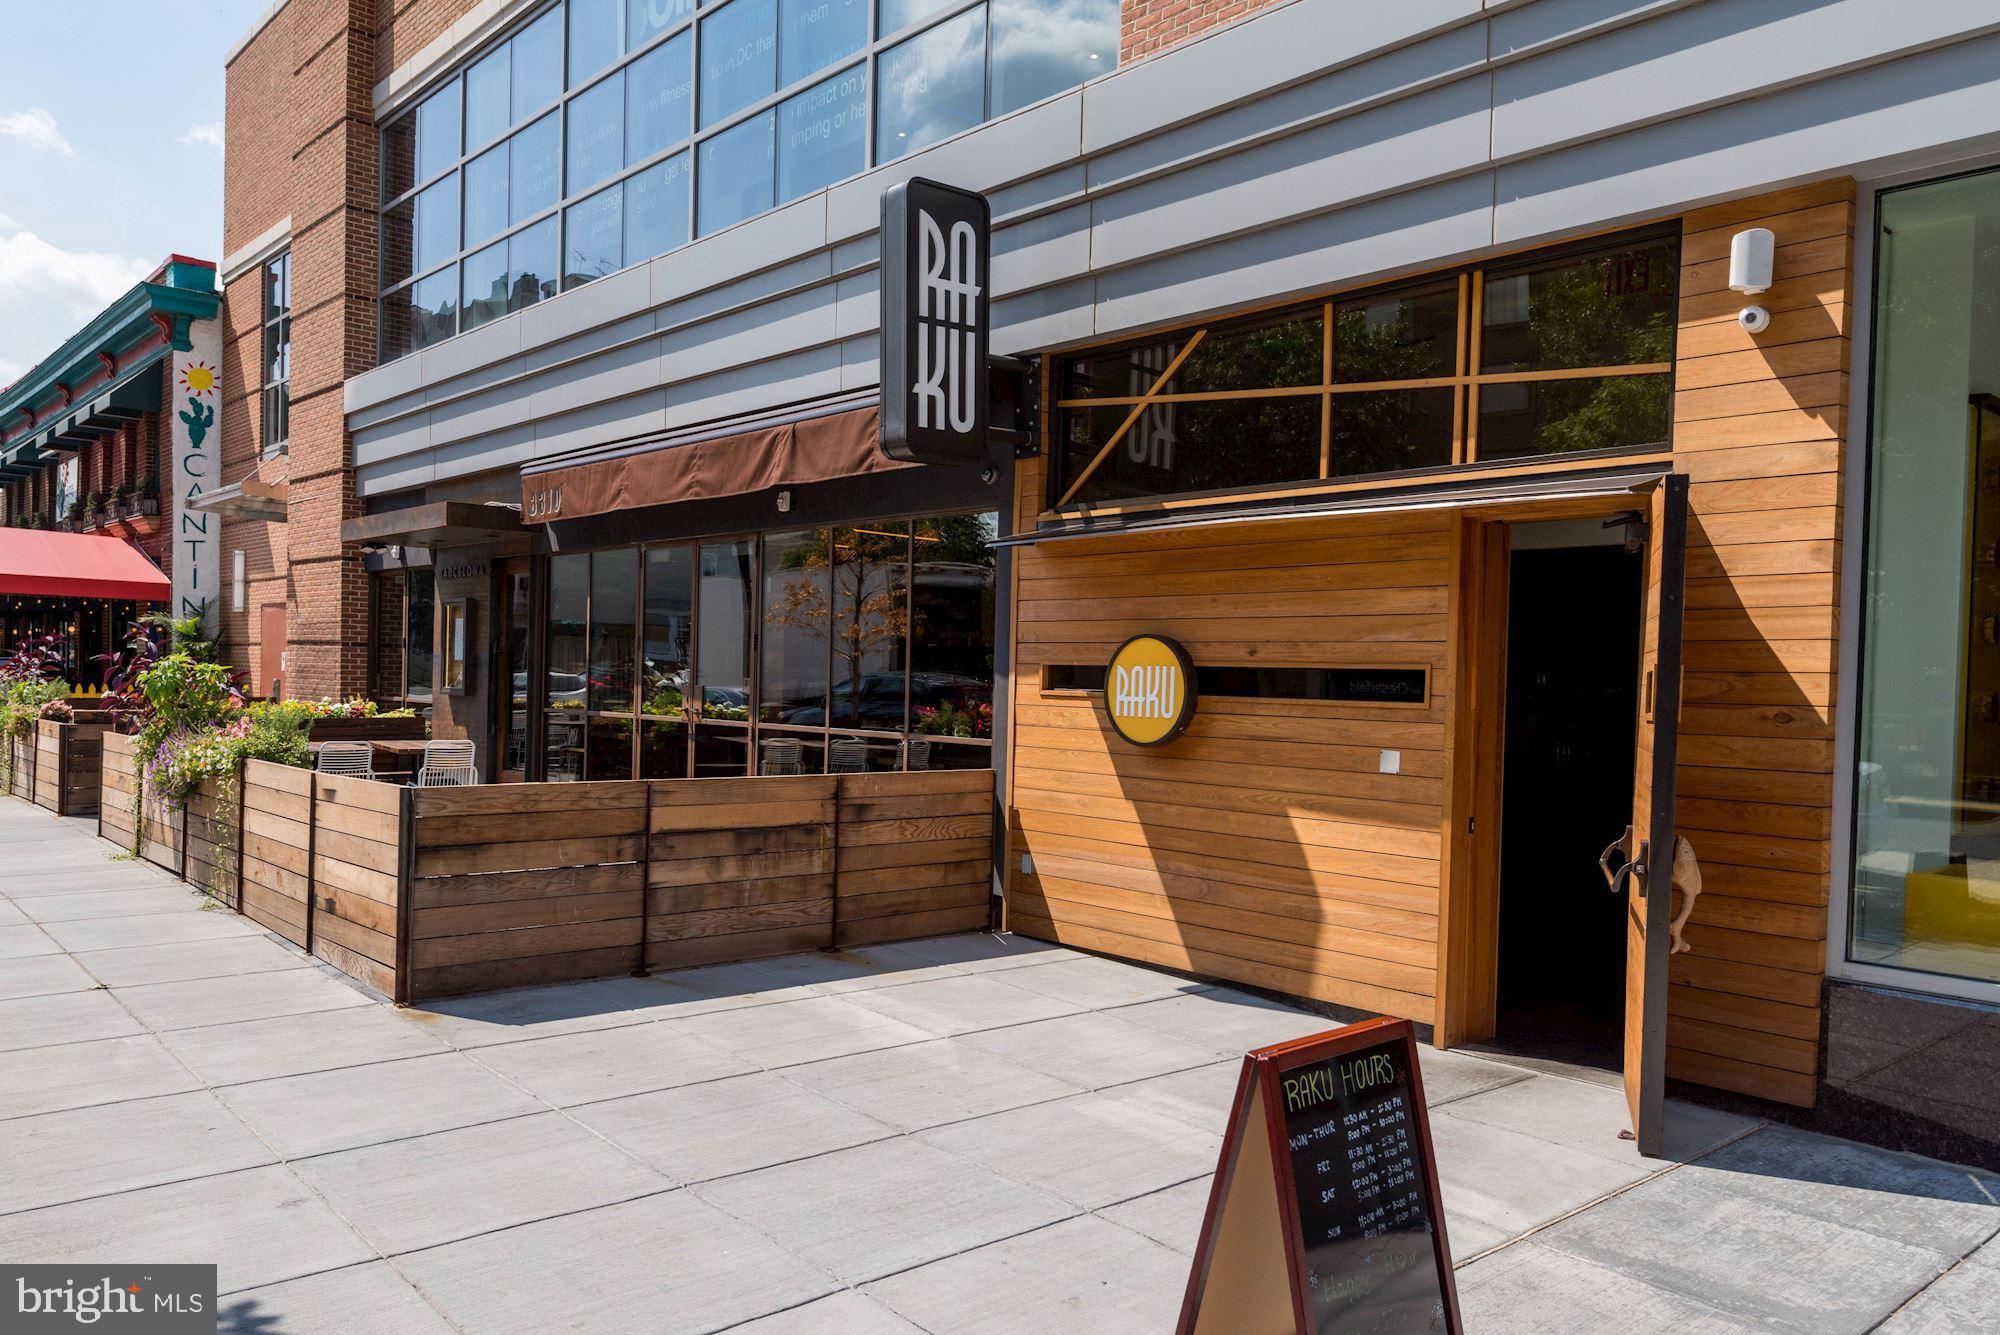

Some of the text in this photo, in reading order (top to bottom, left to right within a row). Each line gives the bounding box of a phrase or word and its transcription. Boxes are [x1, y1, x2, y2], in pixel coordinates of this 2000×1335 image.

[737, 43, 753, 66] DC
[756, 31, 776, 56] that
[840, 77, 856, 97] on
[834, 110, 848, 129] or
[530, 487, 562, 517] 3310
[439, 565, 486, 580] BARCELONA
[1116, 664, 1175, 718] RAKU
[1283, 1053, 1394, 1112] RAKU HOURS
[1392, 1097, 1402, 1108] PM
[1361, 1125, 1371, 1136] PM
[1395, 1110, 1405, 1122] PM
[1316, 1159, 1330, 1174] FRI
[1396, 1128, 1406, 1140] PM
[1367, 1155, 1376, 1166] PM
[1399, 1141, 1409, 1152] PM
[1321, 1187, 1336, 1204] SAT
[1352, 1176, 1369, 1190] 12:00
[1369, 1172, 1379, 1184] PM
[1402, 1157, 1412, 1169] PM
[1405, 1170, 1415, 1182] PM
[1327, 1225, 1342, 1239] SUN
